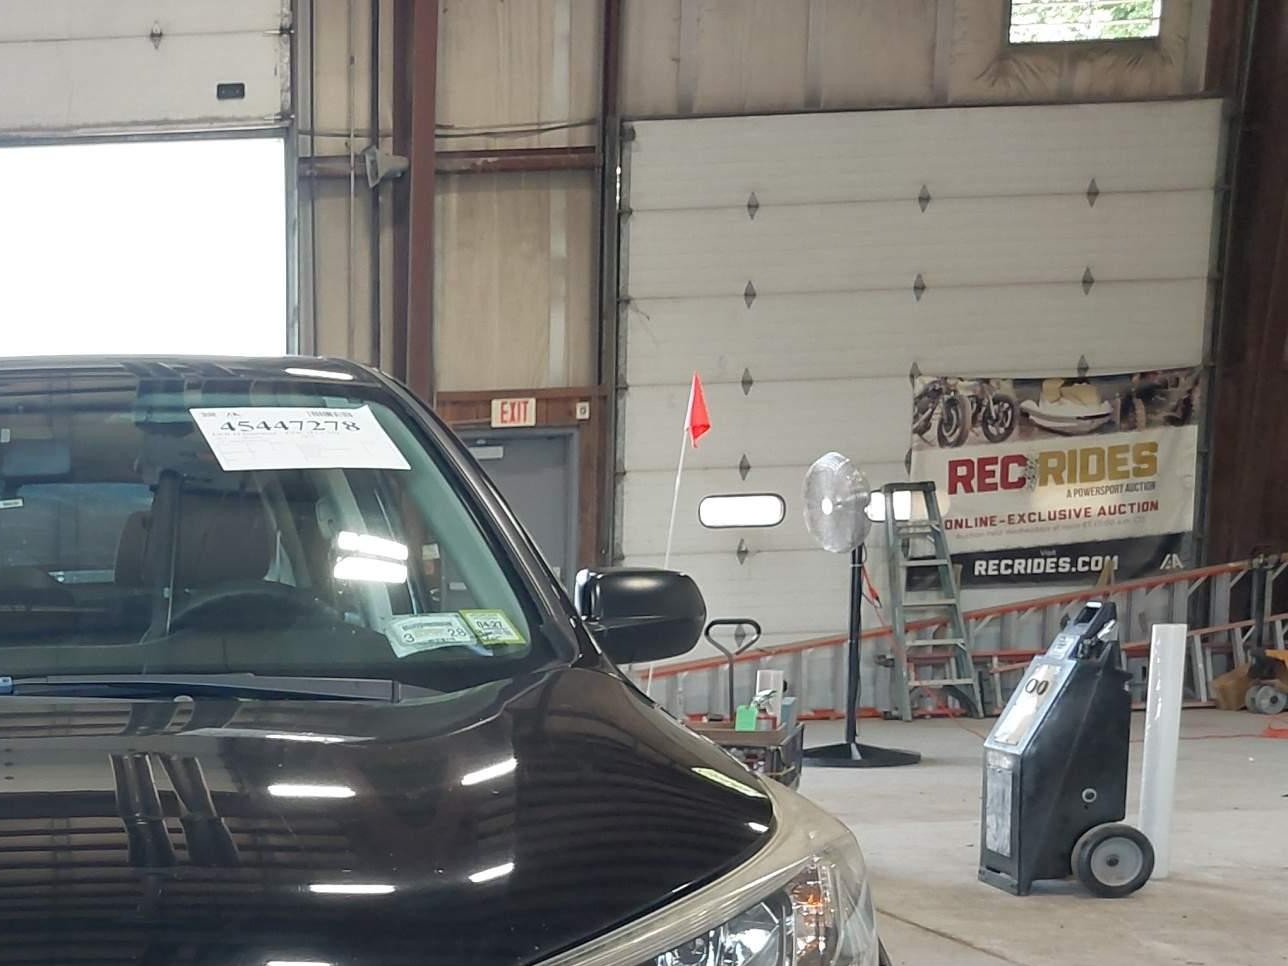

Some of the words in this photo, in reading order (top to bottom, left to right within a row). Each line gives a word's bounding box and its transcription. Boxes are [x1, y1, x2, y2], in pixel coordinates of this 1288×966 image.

[500, 400, 529, 424] EXIT
[219, 420, 361, 432] 45447278
[948, 453, 1027, 496] REC
[1038, 441, 1159, 488] RIDES
[1073, 484, 1124, 498] POWERSPORT
[1125, 481, 1156, 494] AUCTION
[944, 507, 1092, 531] ONLINE-EXCLUSIVE
[1097, 500, 1159, 517] AUCTION
